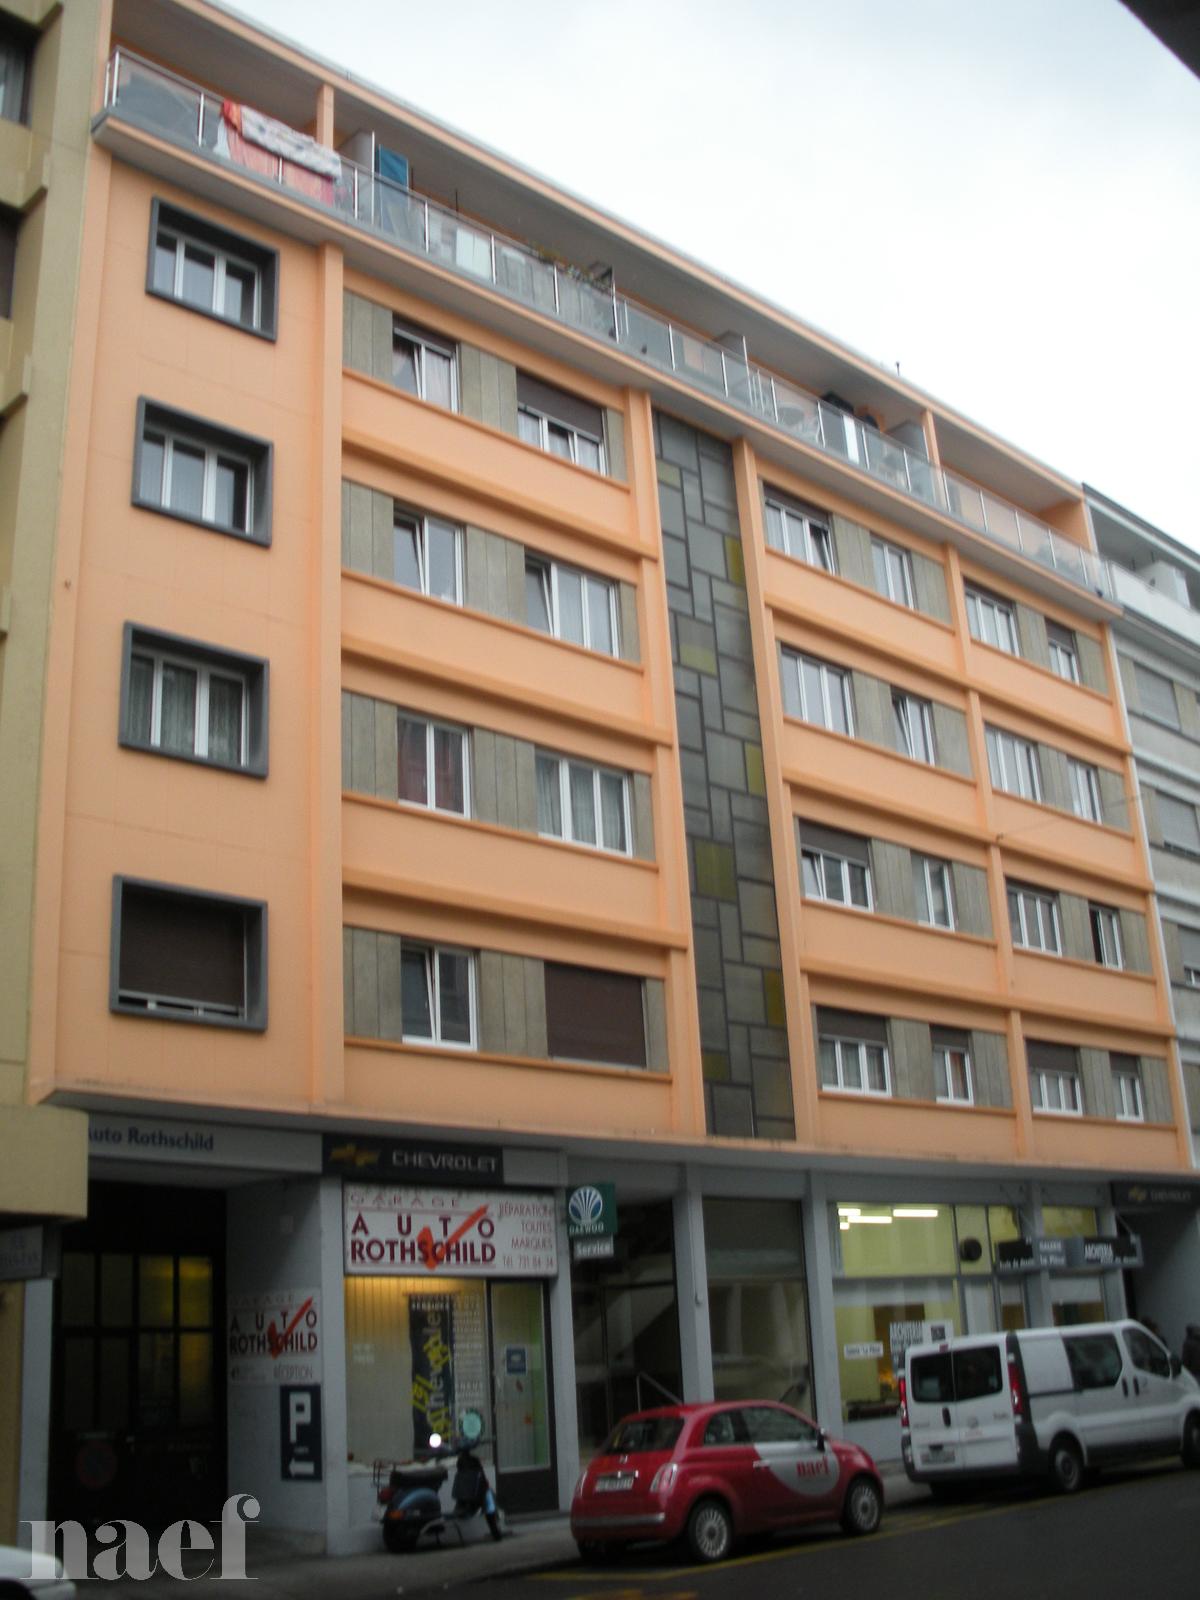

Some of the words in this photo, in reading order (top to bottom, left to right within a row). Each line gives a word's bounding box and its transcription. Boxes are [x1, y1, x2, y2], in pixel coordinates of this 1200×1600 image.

[127, 1126, 214, 1151] Rothschild
[392, 1151, 497, 1174] CHEVROLET
[350, 1238, 496, 1265] ROTHSCHILD
[289, 1391, 312, 1443] P
